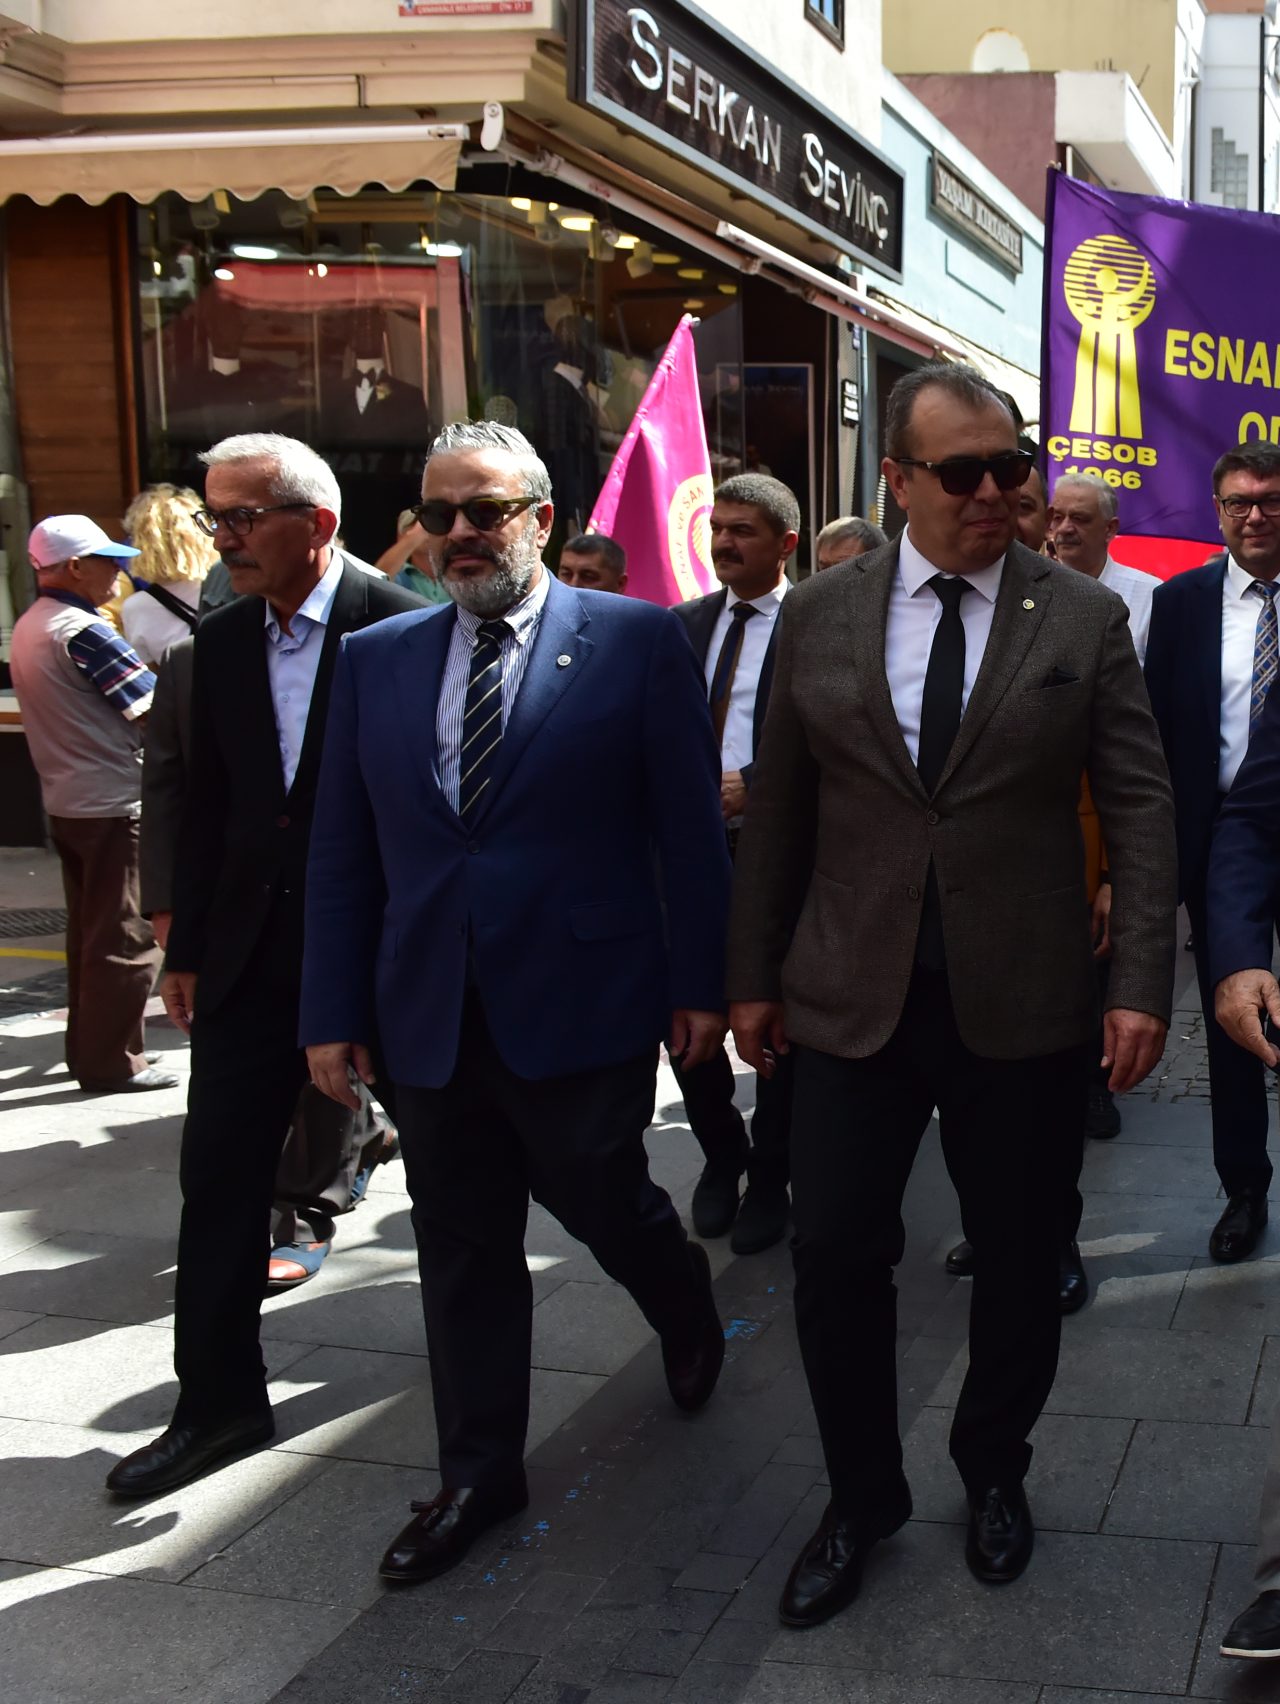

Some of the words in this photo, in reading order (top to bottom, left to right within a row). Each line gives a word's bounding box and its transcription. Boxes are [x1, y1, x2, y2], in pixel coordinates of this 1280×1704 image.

[626, 7, 782, 174] SERKAN
[801, 132, 889, 249] SEVİNÇ
[1047, 435, 1158, 467] ÇESOB
